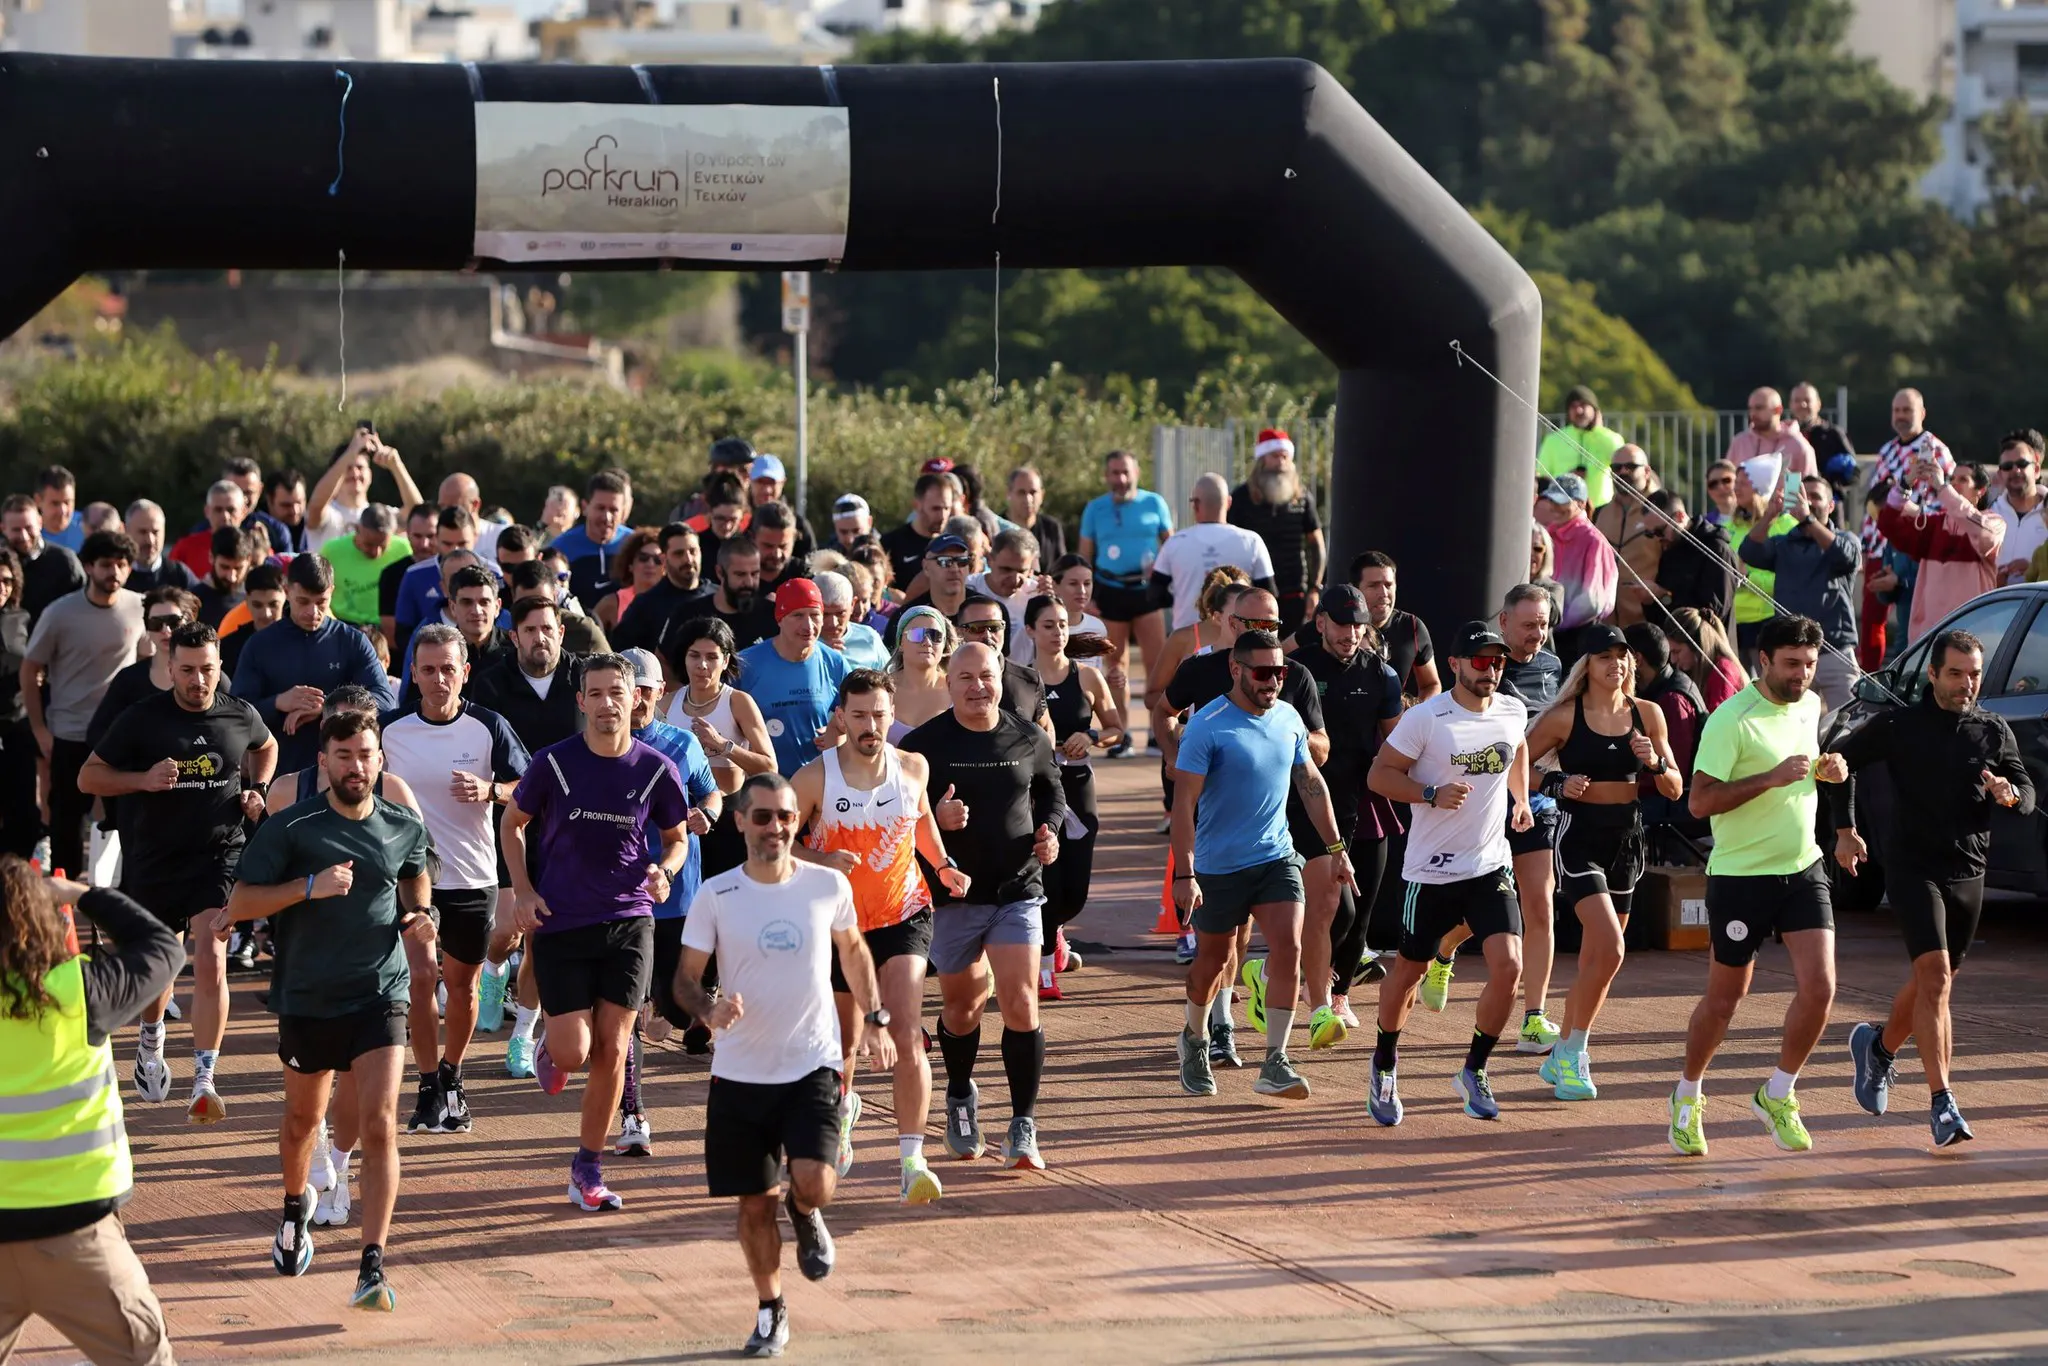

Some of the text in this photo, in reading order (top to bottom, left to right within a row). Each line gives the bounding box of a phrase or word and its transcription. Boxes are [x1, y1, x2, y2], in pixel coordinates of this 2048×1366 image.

[542, 151, 678, 197] parkrun
[694, 170, 765, 184] Ενετικών
[607, 195, 679, 207] Heraklion
[694, 188, 747, 202] Τειχών
[178, 760, 199, 768] IKRO
[1450, 752, 1487, 766] MIKRO
[183, 767, 199, 775] JIM
[1468, 762, 1485, 773] JIM
[174, 780, 206, 790] unning
[582, 811, 636, 824] FRONTRUNNER
[1732, 926, 1743, 935] 12
